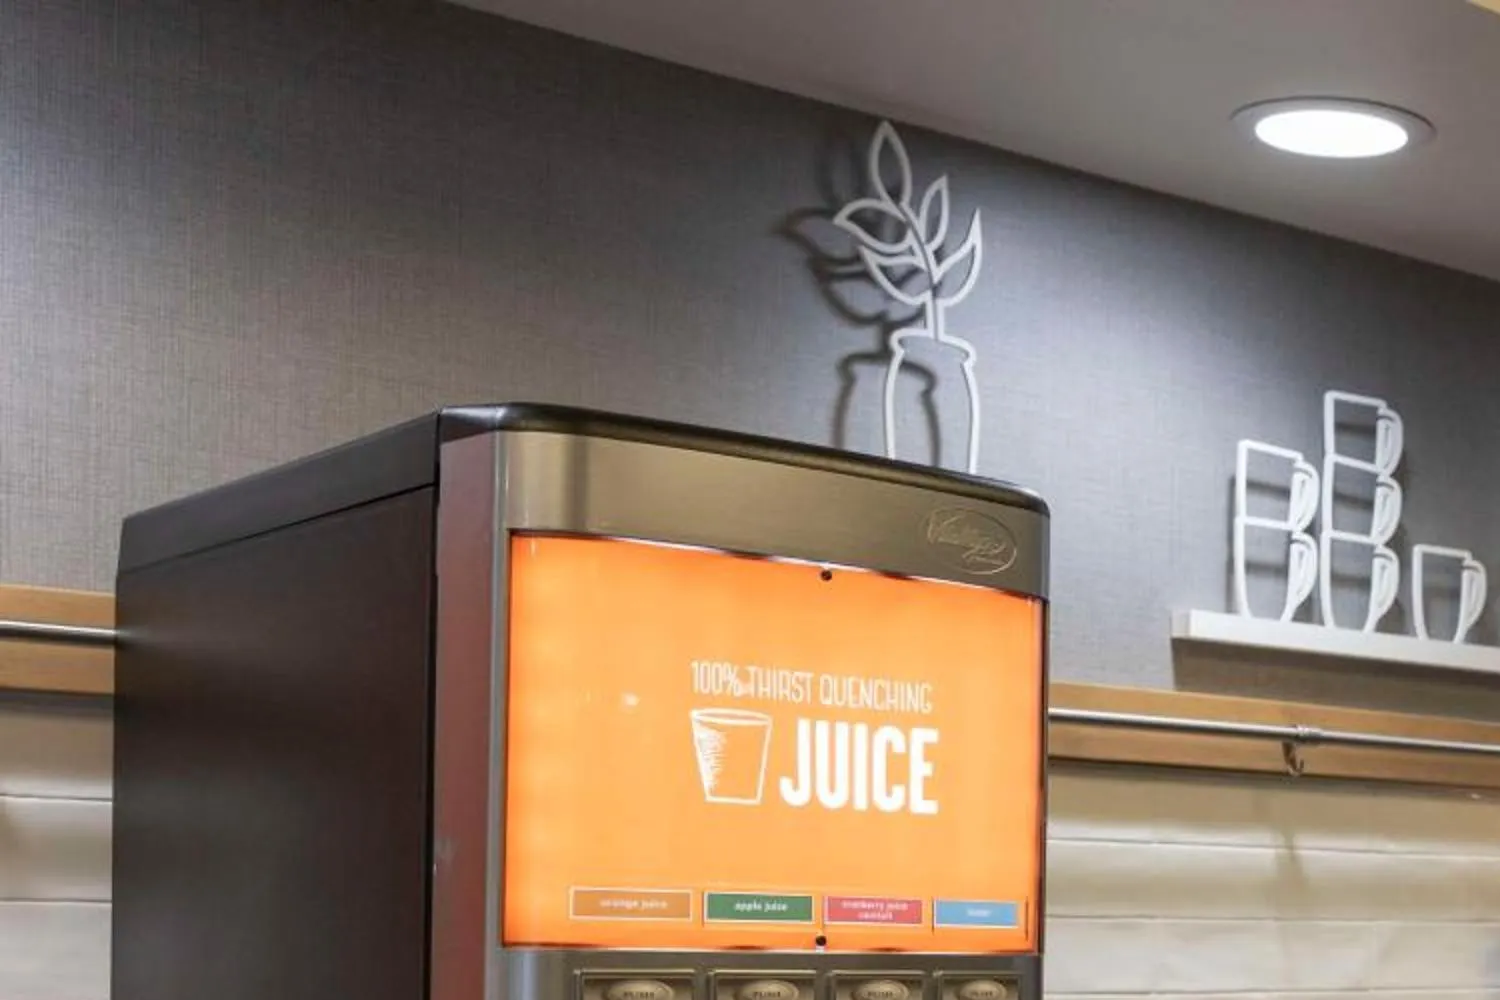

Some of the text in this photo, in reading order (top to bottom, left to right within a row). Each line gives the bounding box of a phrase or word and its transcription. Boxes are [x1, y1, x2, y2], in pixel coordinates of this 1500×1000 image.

[745, 665, 813, 704] THIRST
[819, 673, 933, 714] QUENCHING
[779, 717, 939, 815] JUICE
[734, 898, 789, 912] apple juice
